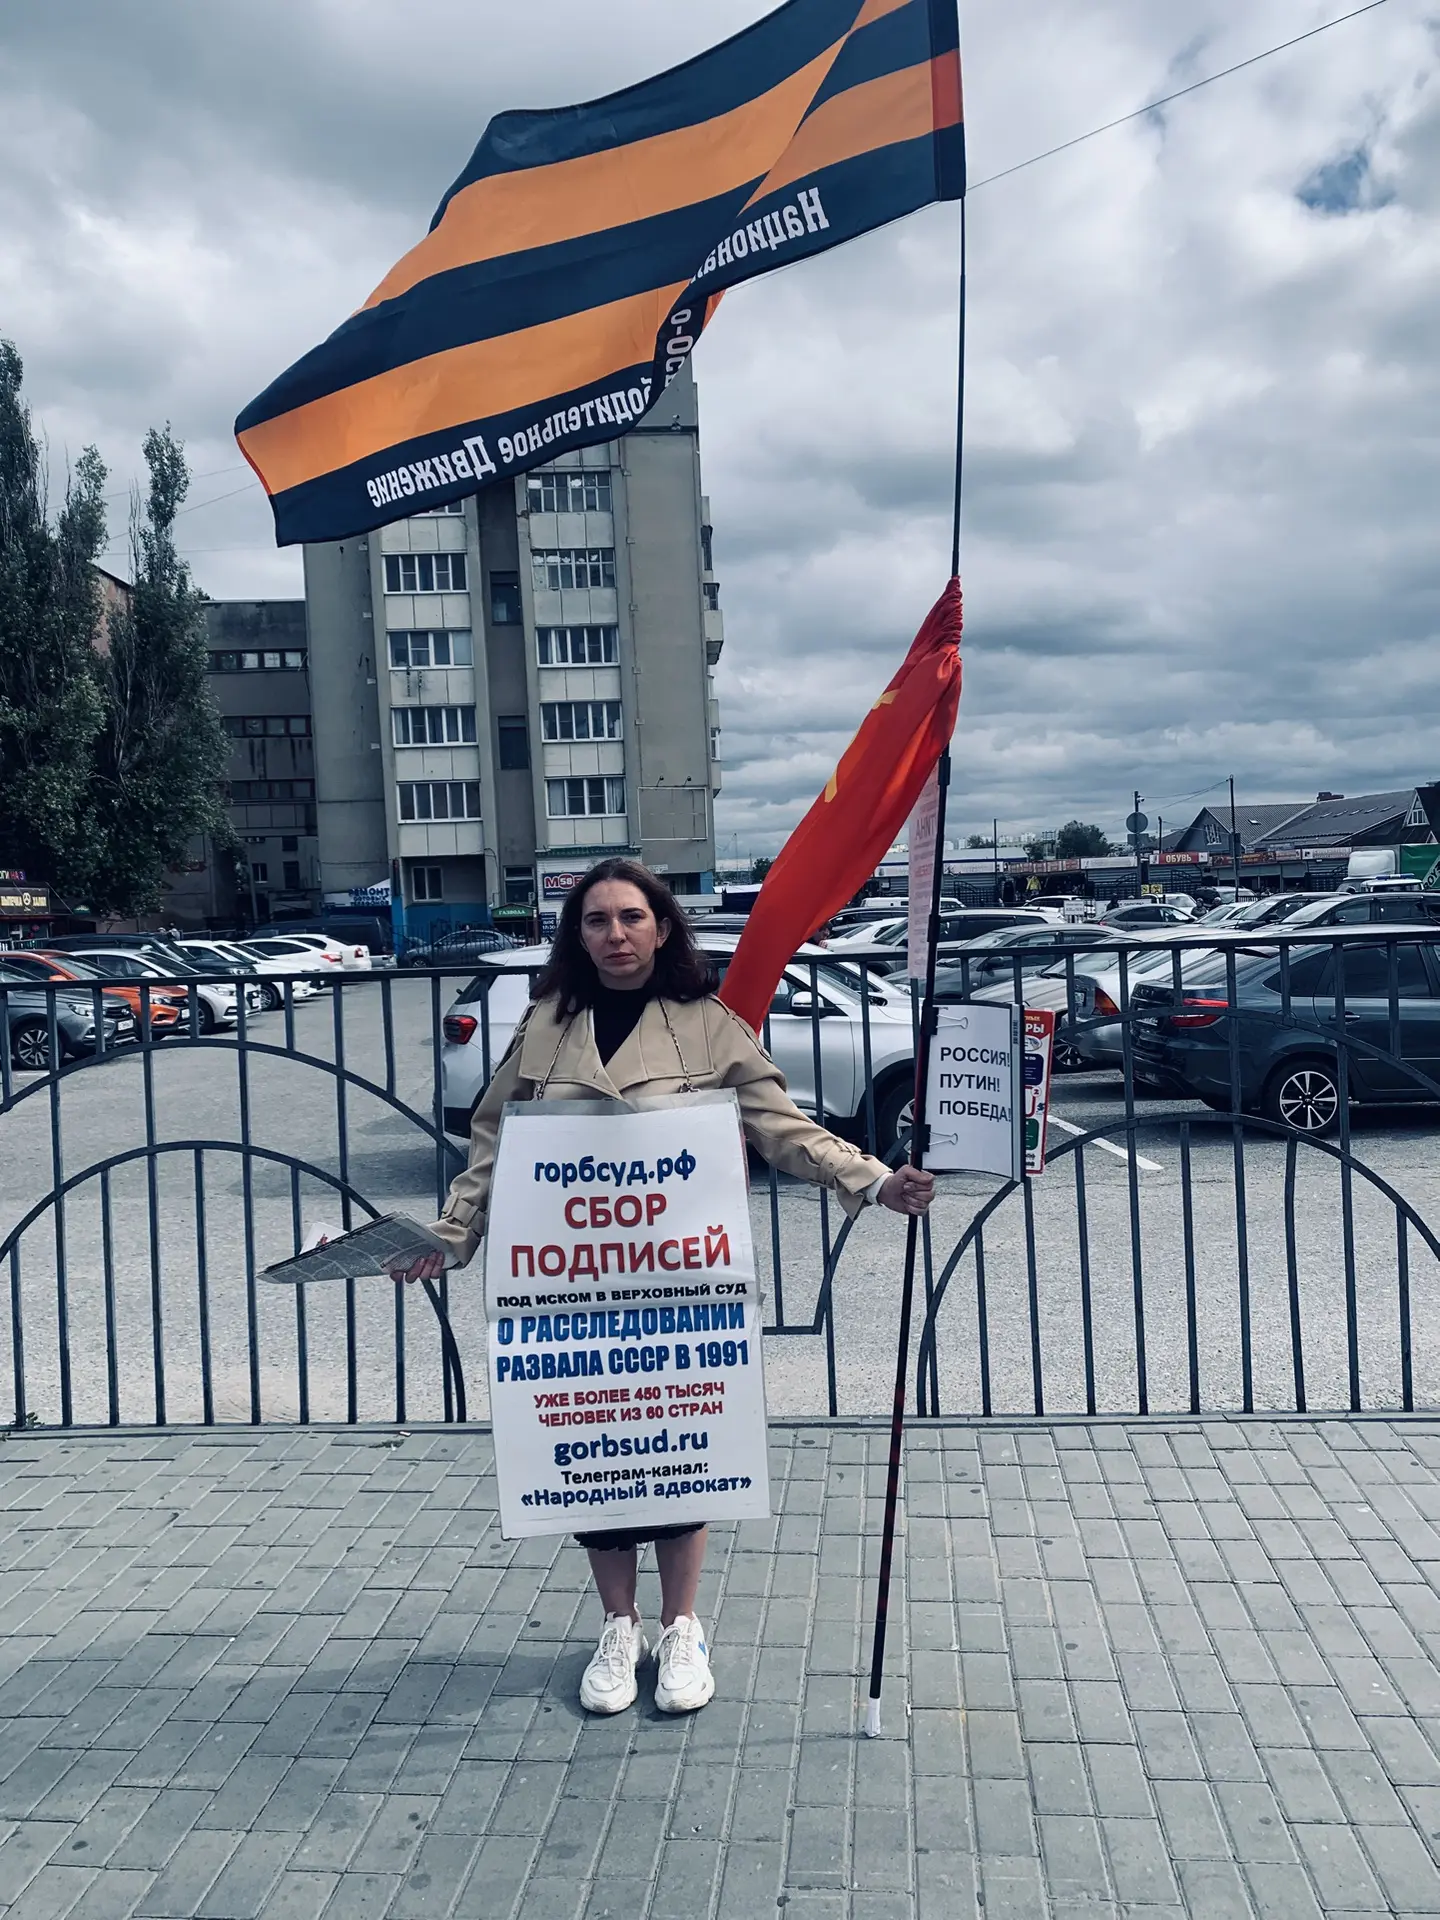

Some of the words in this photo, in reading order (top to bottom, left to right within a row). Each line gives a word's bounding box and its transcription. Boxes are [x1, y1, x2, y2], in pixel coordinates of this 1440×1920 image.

[1165, 853, 1192, 864] ОБУВЬ
[940, 1046, 1011, 1068] РОССИЯ!
[939, 1073, 1001, 1093] ПУТИН!
[939, 1100, 1011, 1123] ПОБЕДА!
[534, 1149, 696, 1188] горбсуд.рф
[564, 1193, 667, 1229] СБОР
[511, 1224, 731, 1283] ПОДПИСЕЙ
[497, 1295, 532, 1308] ПОД
[536, 1291, 592, 1305] ИСКОМ
[596, 1291, 607, 1302] В
[611, 1283, 712, 1301] ВЕРХОВНЫЙ
[715, 1282, 748, 1296] СУД
[498, 1317, 514, 1345] О
[521, 1302, 745, 1343] РАССЛЕДОВАНИИ
[497, 1350, 604, 1382] РАЗВАЛА
[608, 1345, 670, 1375] СССР
[675, 1343, 691, 1369] В
[695, 1339, 749, 1368] 1991
[534, 1393, 570, 1408] УЖЕ
[574, 1388, 630, 1406] БОЛЕЕ
[664, 1381, 725, 1399] ТЫСЯЧ
[538, 1409, 617, 1427] ЧЕЛОВЕК
[620, 1406, 642, 1421] ИЗ
[646, 1405, 664, 1420] 60
[668, 1401, 723, 1417] СТРАН
[553, 1429, 709, 1466] gorbsud.ru
[561, 1462, 709, 1485] Телеграм-канал:
[520, 1480, 648, 1508] «Народный
[653, 1476, 752, 1498] адвокат»
